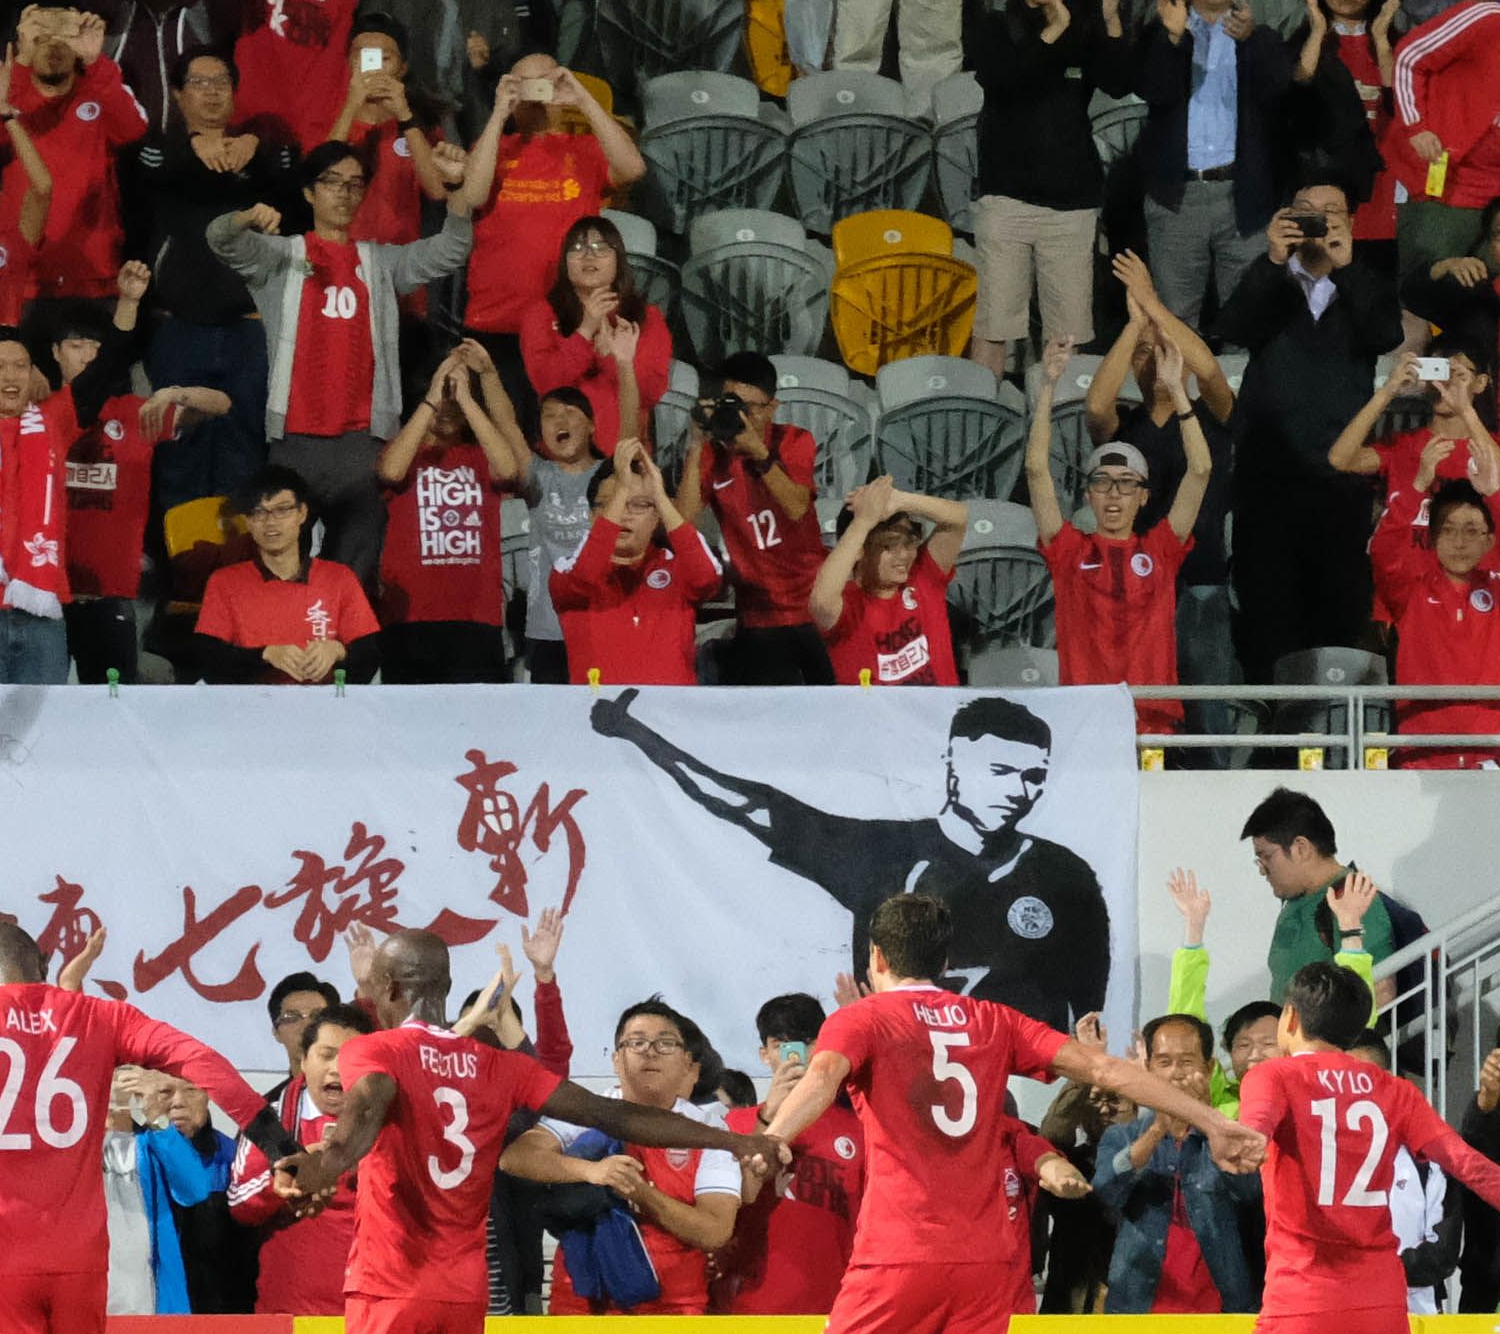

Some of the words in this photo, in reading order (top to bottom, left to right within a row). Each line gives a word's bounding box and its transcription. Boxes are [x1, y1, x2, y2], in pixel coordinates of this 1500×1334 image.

[320, 284, 358, 320] 10
[417, 465, 476, 483] HOW
[416, 482, 483, 507] HIGH
[419, 507, 441, 531] IS
[747, 509, 782, 550] 12
[419, 530, 481, 556] HIGH
[303, 598, 335, 640] 香
[6, 1007, 58, 1035] ALEX
[928, 1030, 980, 1140] 5
[426, 1085, 476, 1190] 3
[1309, 1095, 1391, 1208] 12
